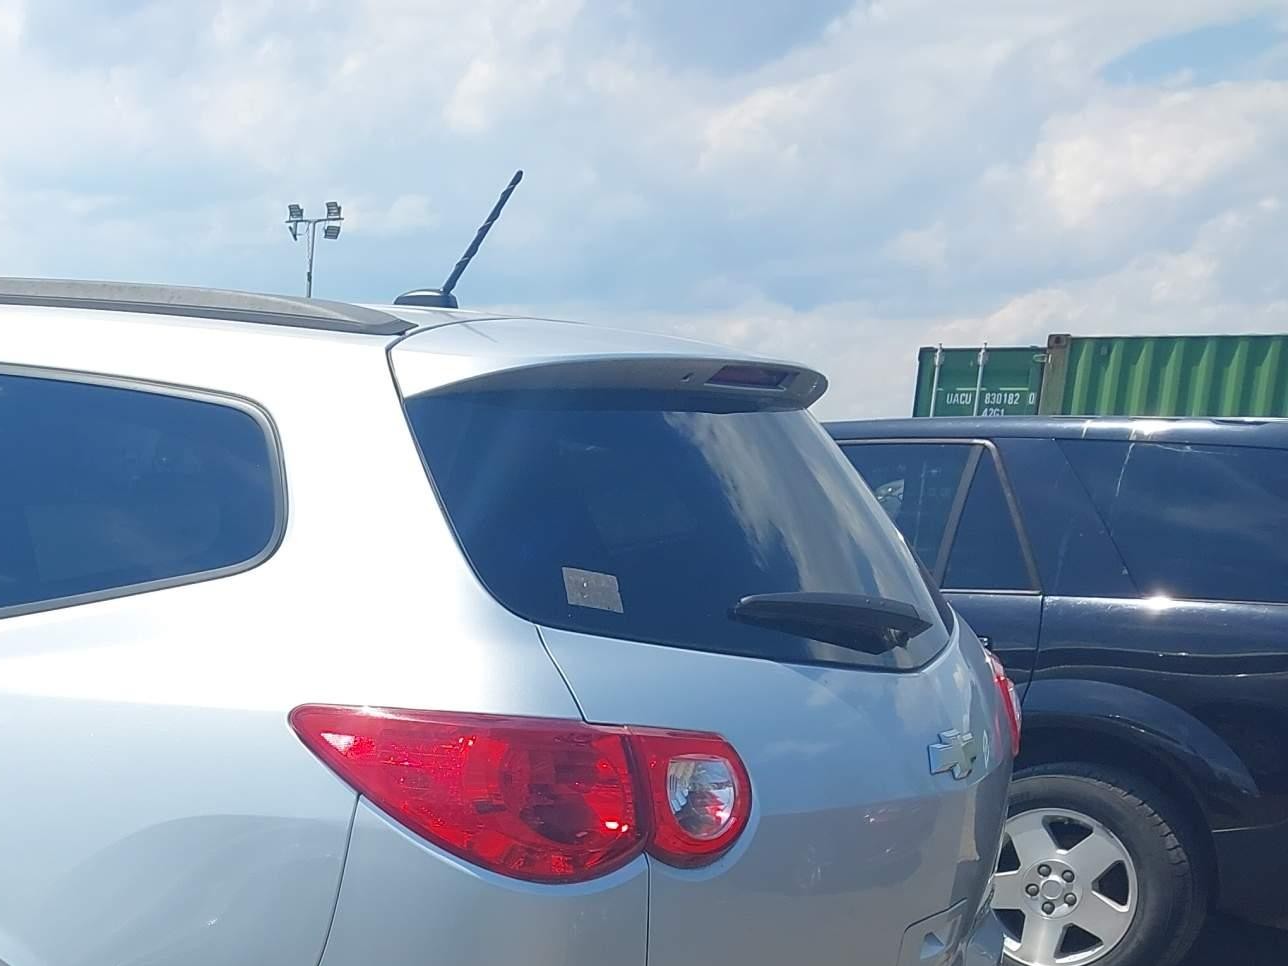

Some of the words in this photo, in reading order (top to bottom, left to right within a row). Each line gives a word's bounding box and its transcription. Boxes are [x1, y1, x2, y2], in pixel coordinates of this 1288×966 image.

[946, 392, 972, 405] UACU
[985, 392, 1021, 405] 830182
[1028, 392, 1036, 405] 0
